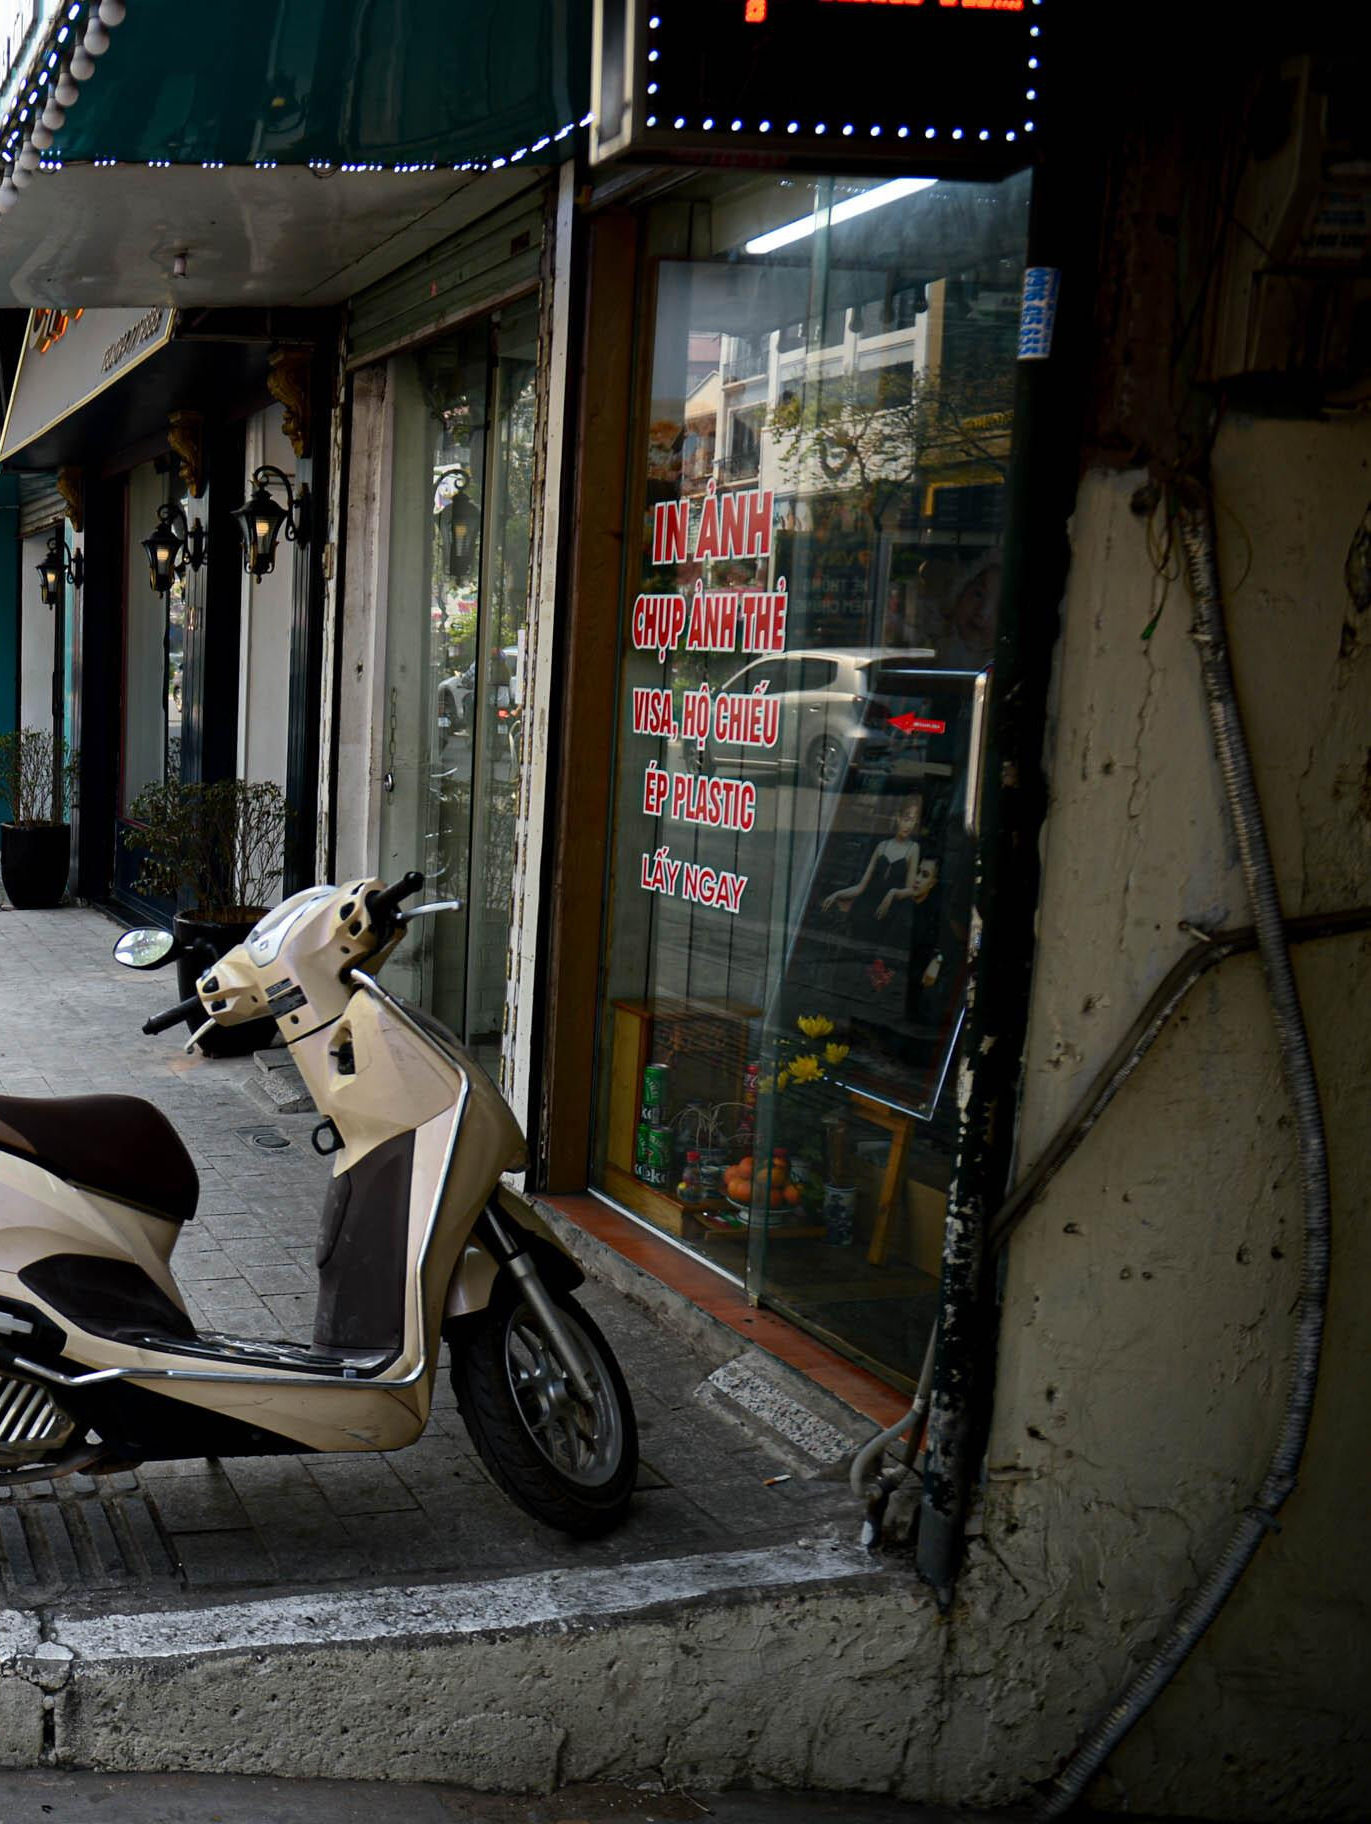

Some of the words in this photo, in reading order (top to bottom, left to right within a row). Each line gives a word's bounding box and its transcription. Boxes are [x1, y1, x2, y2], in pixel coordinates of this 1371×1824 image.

[652, 499, 690, 565] IN
[695, 478, 775, 562] ẢNH
[632, 594, 687, 664] CHỤP
[686, 578, 738, 652] ẢNH
[740, 575, 788, 654] THẺ
[632, 686, 679, 743] VISA,
[682, 682, 710, 750] HỘ
[714, 679, 781, 748] CHIẾU
[642, 760, 670, 816] ÉP
[671, 773, 757, 832] PLASTIC
[641, 845, 682, 896] LẤY
[682, 862, 748, 914] NGAY
